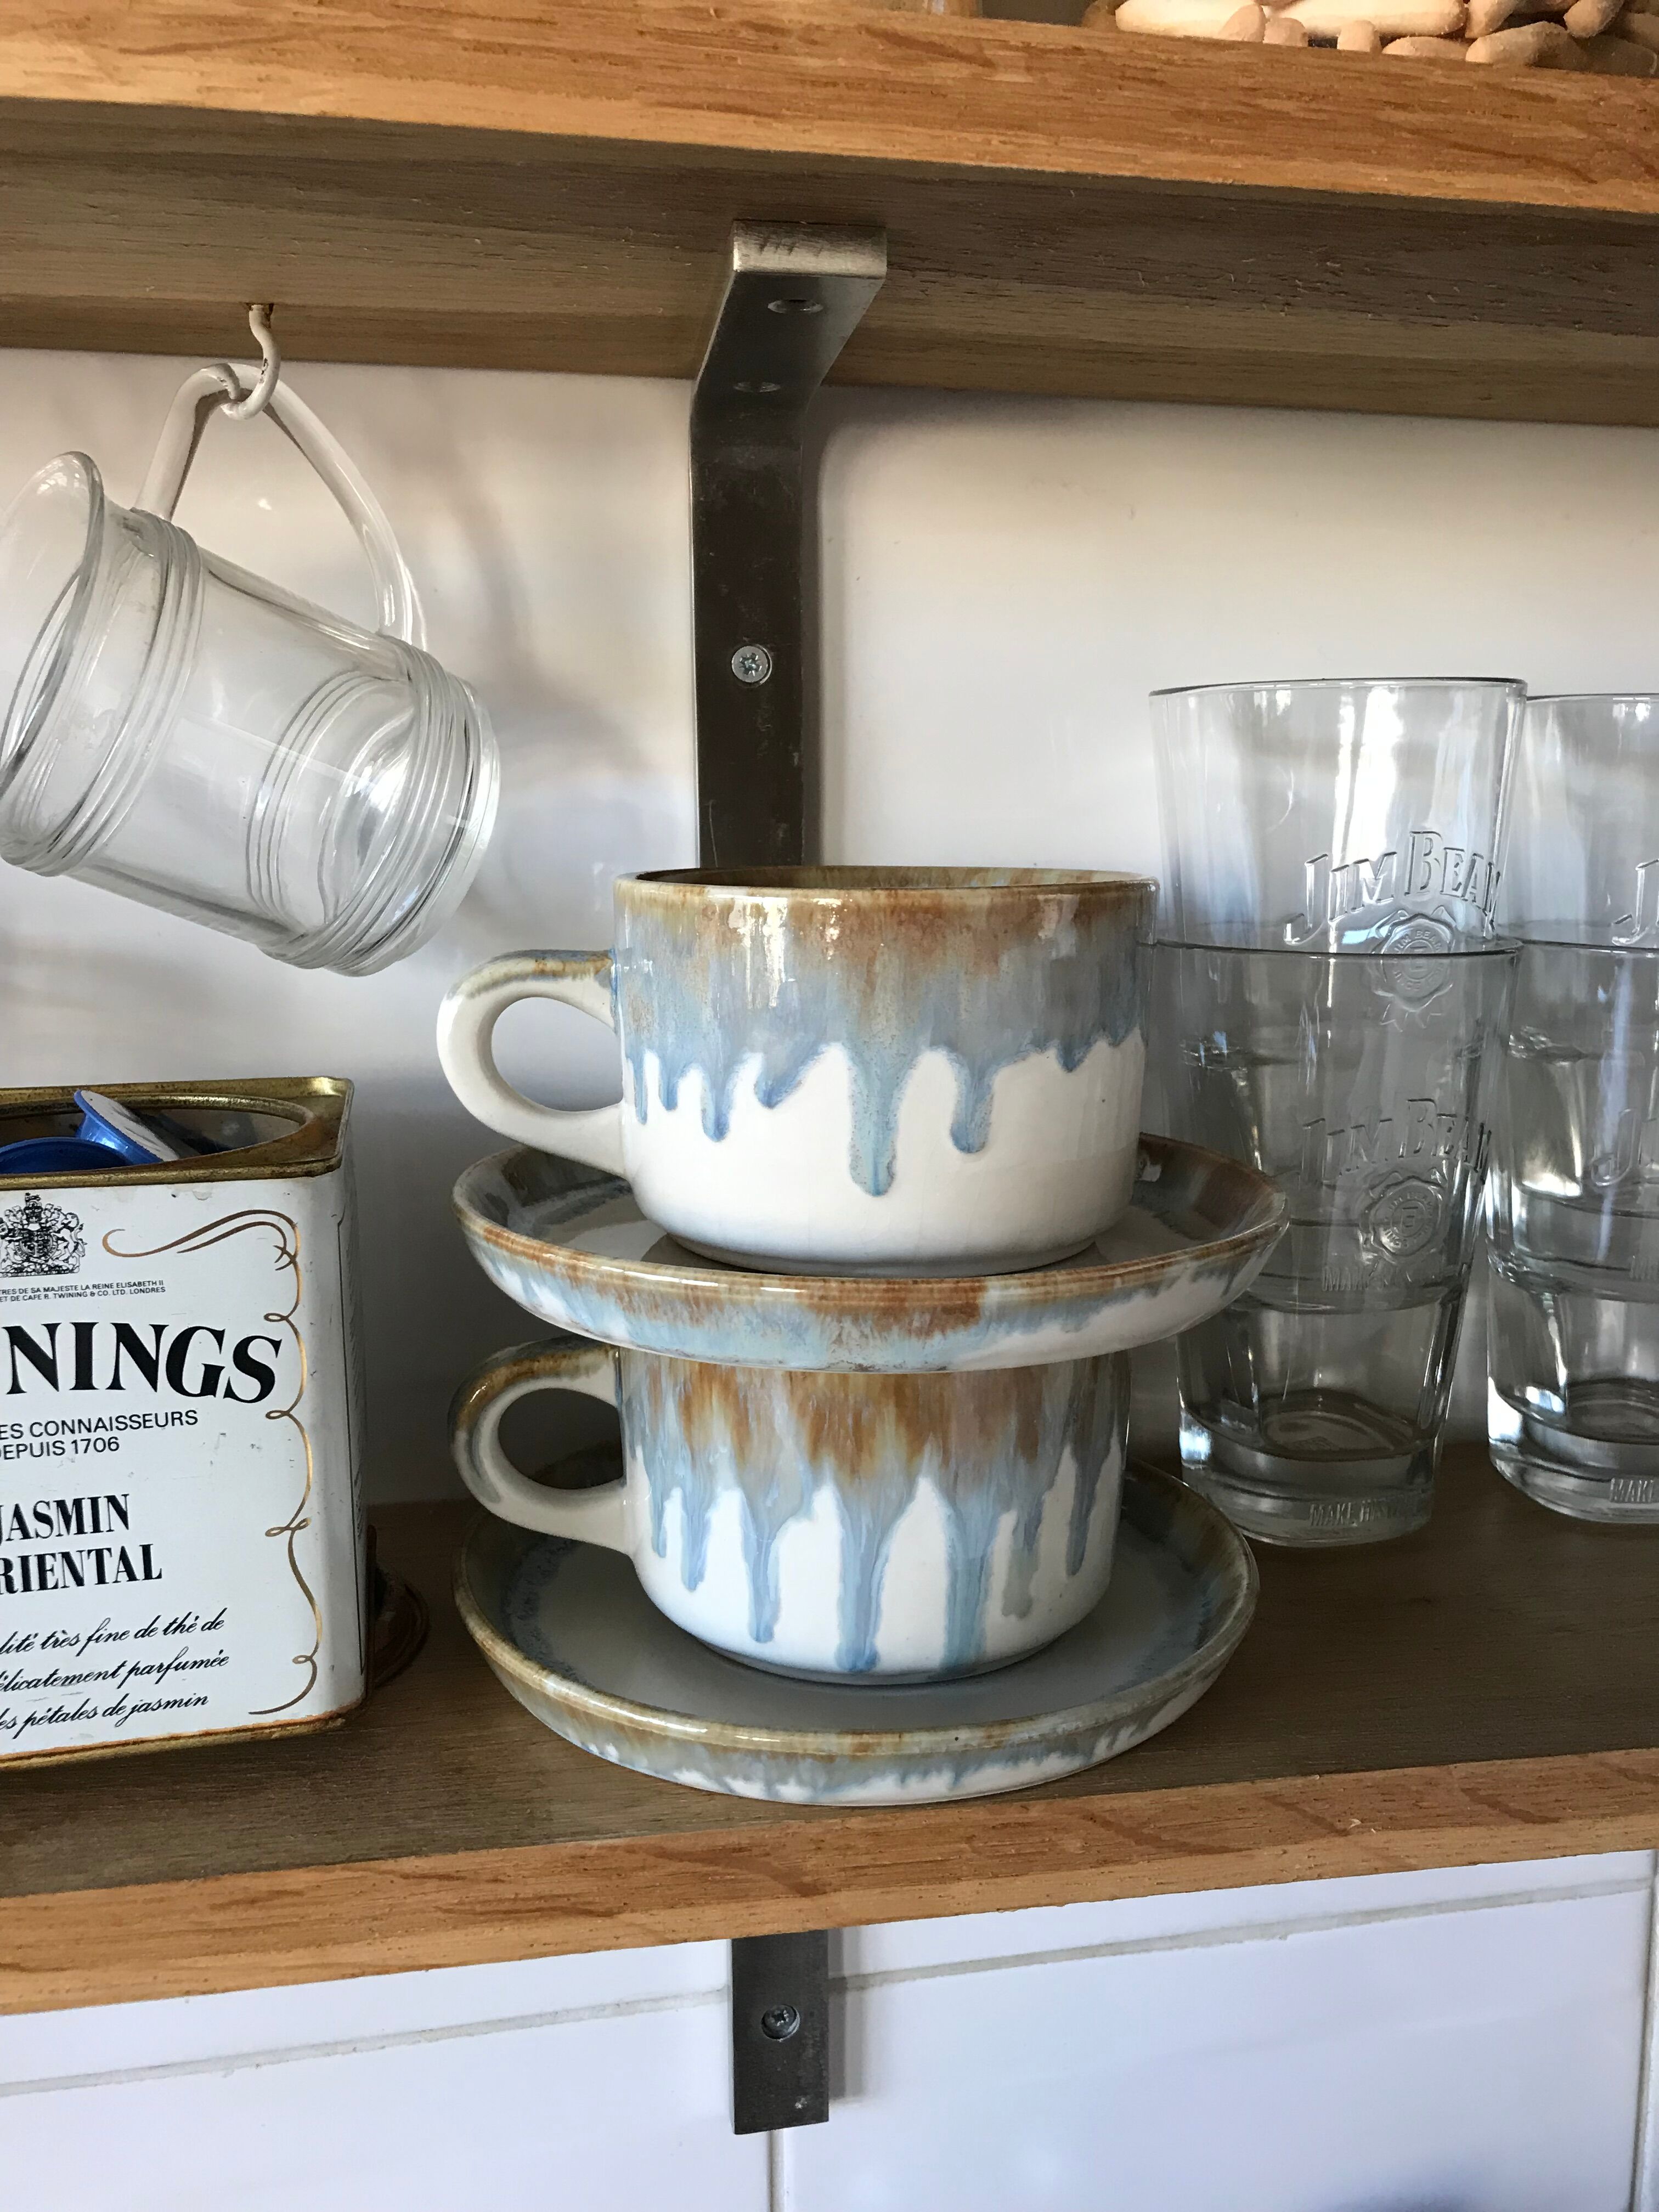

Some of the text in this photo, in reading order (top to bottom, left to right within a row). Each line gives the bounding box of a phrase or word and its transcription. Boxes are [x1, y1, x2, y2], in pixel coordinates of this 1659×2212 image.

[1612, 858, 1659, 946] J
[53, 1291, 88, 1299] TWINING
[129, 1286, 166, 1295] LONDRES
[116, 1280, 157, 1288] ELISABETH
[2, 1322, 282, 1404] NINGS
[0, 1409, 198, 1440] ES CONNAISSEURS
[0, 1436, 120, 1460] EPUIS 1706
[0, 1544, 162, 1594] RIENTAL
[40, 1629, 81, 1650] très
[75, 1617, 130, 1657] fine
[134, 1615, 162, 1639] de
[162, 1611, 200, 1635] thé
[201, 1607, 228, 1632] de
[0, 1646, 229, 1692] élicatement parfumée
[12, 1698, 98, 1739] pétales
[102, 1693, 130, 1717] de
[115, 1692, 208, 1728] jasmin
